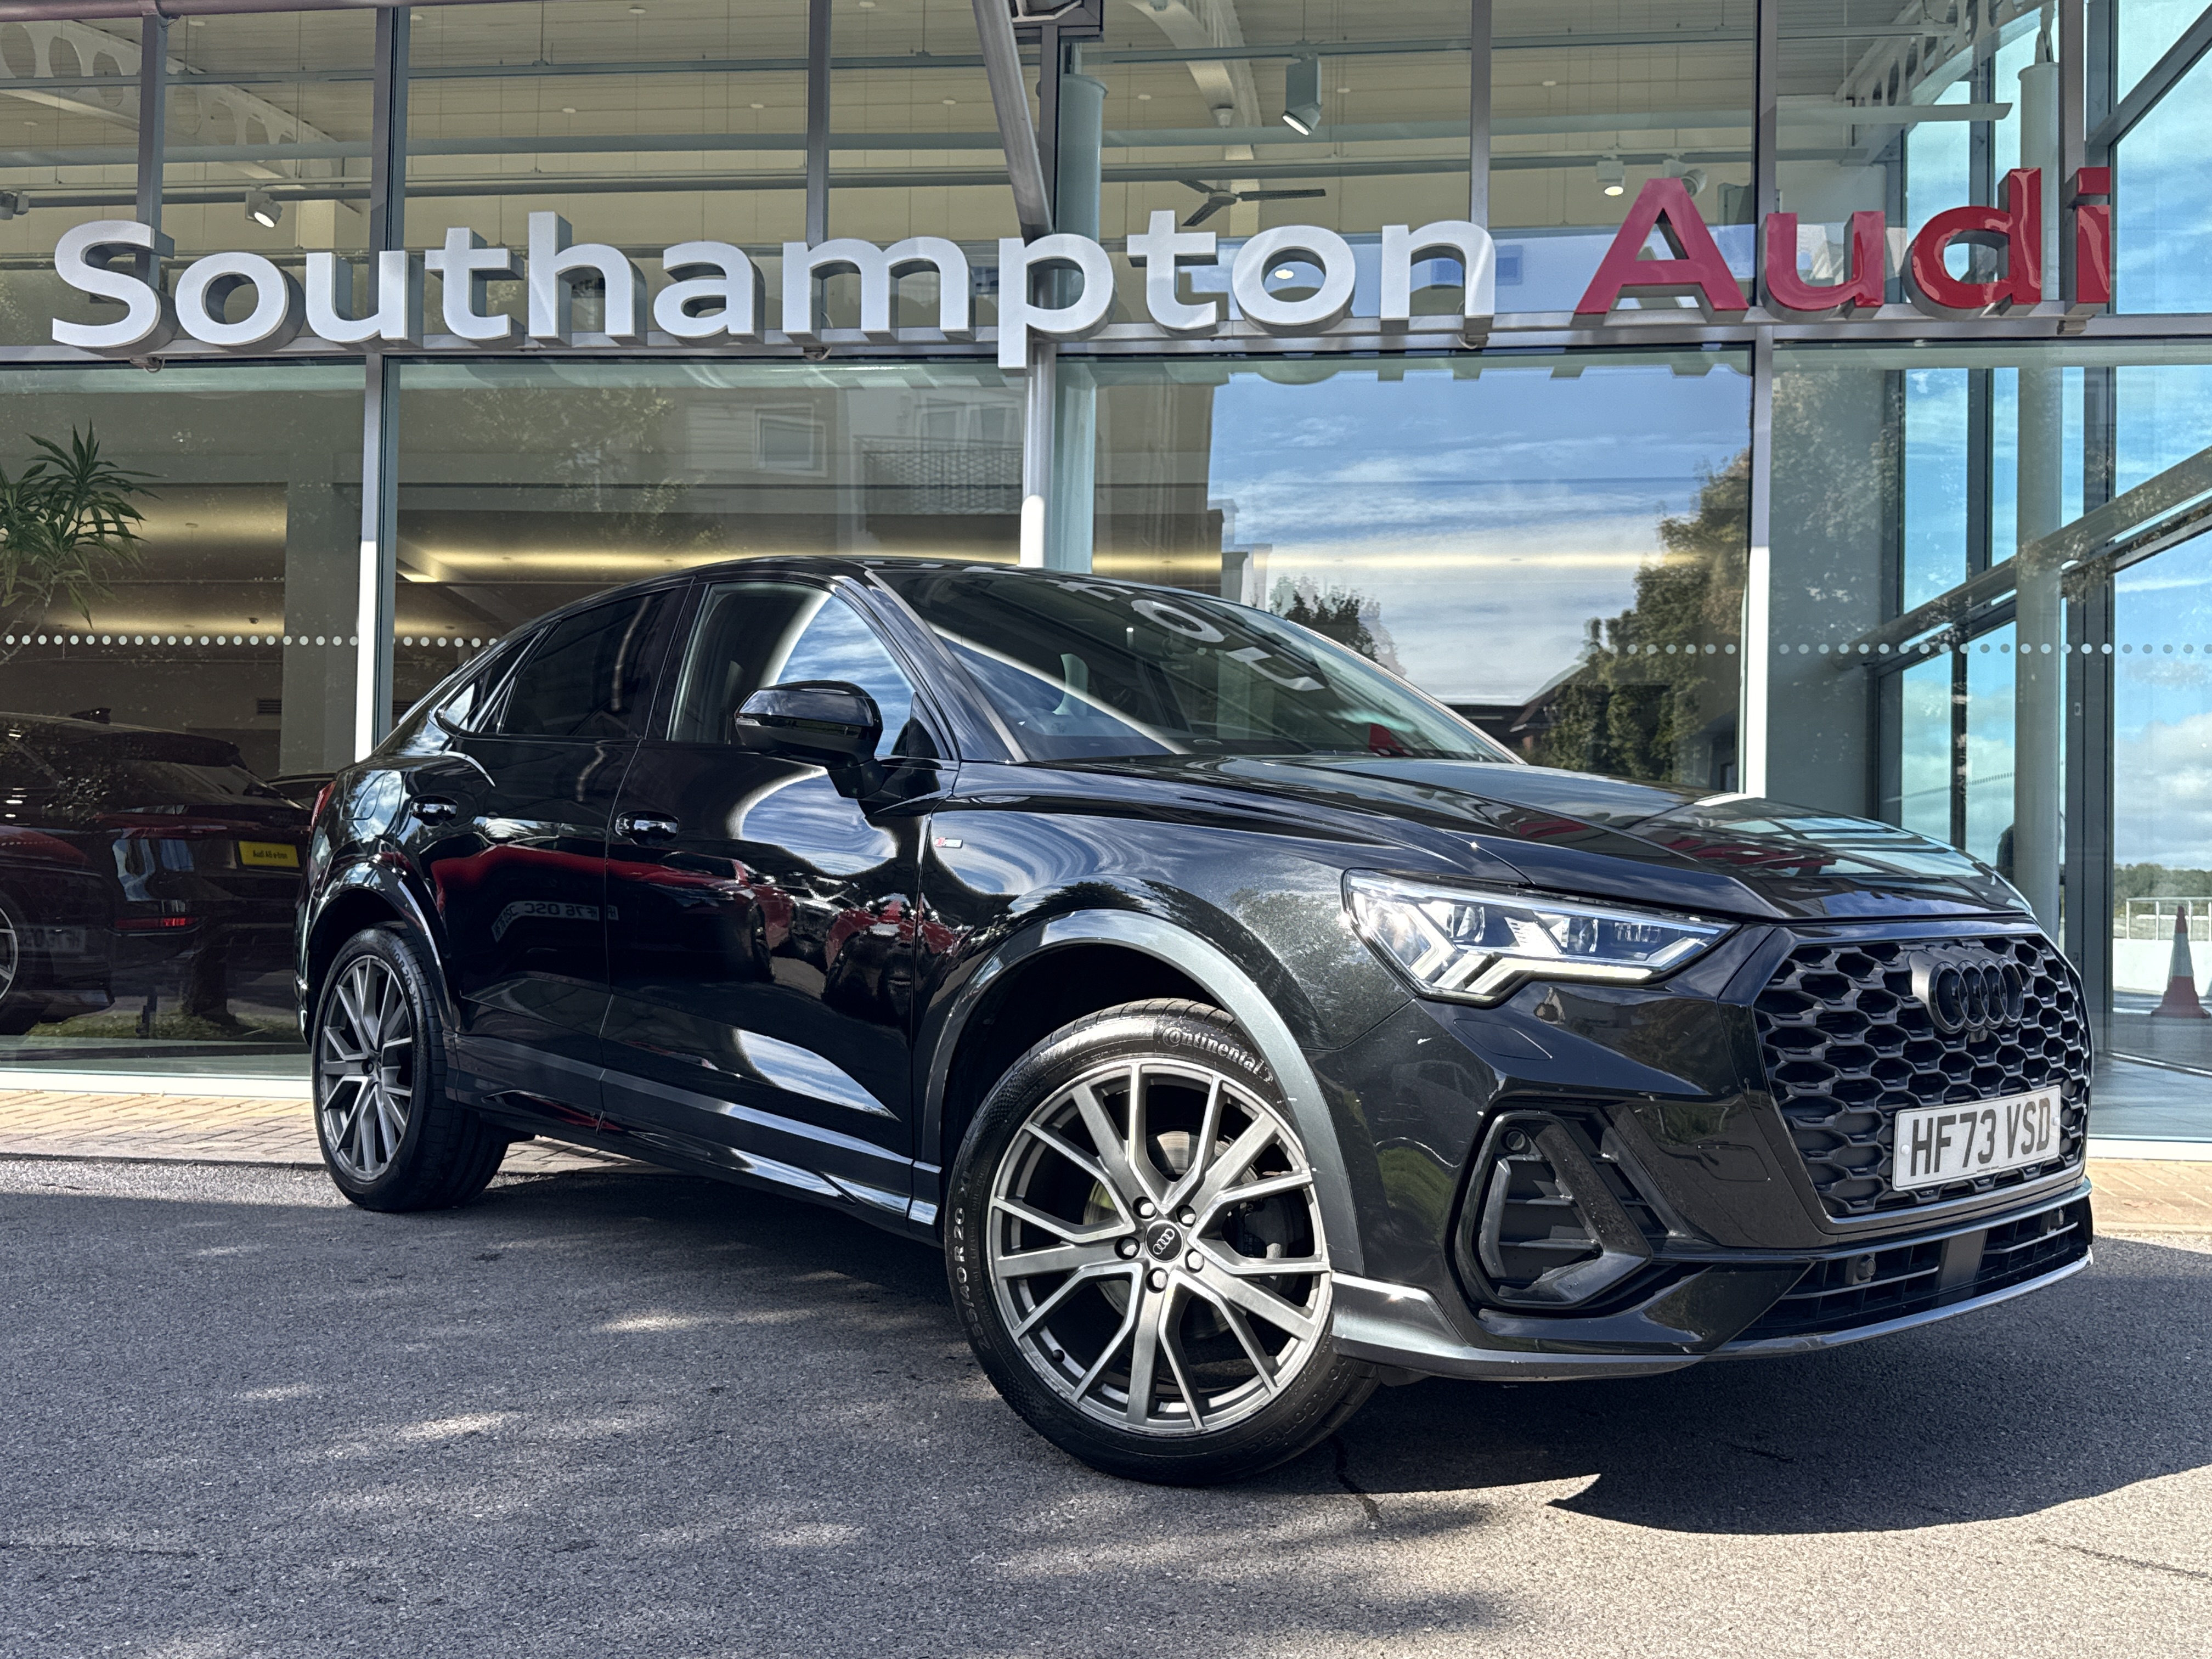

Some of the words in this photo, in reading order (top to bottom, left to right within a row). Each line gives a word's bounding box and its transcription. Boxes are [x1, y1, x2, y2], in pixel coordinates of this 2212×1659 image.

[52, 210, 1496, 369] Southampton
[1571, 167, 2111, 320] Audi
[1162, 1026, 1265, 1075] Continental
[1910, 1109, 1996, 1177] HF73
[2006, 1097, 2051, 1159] VSD
